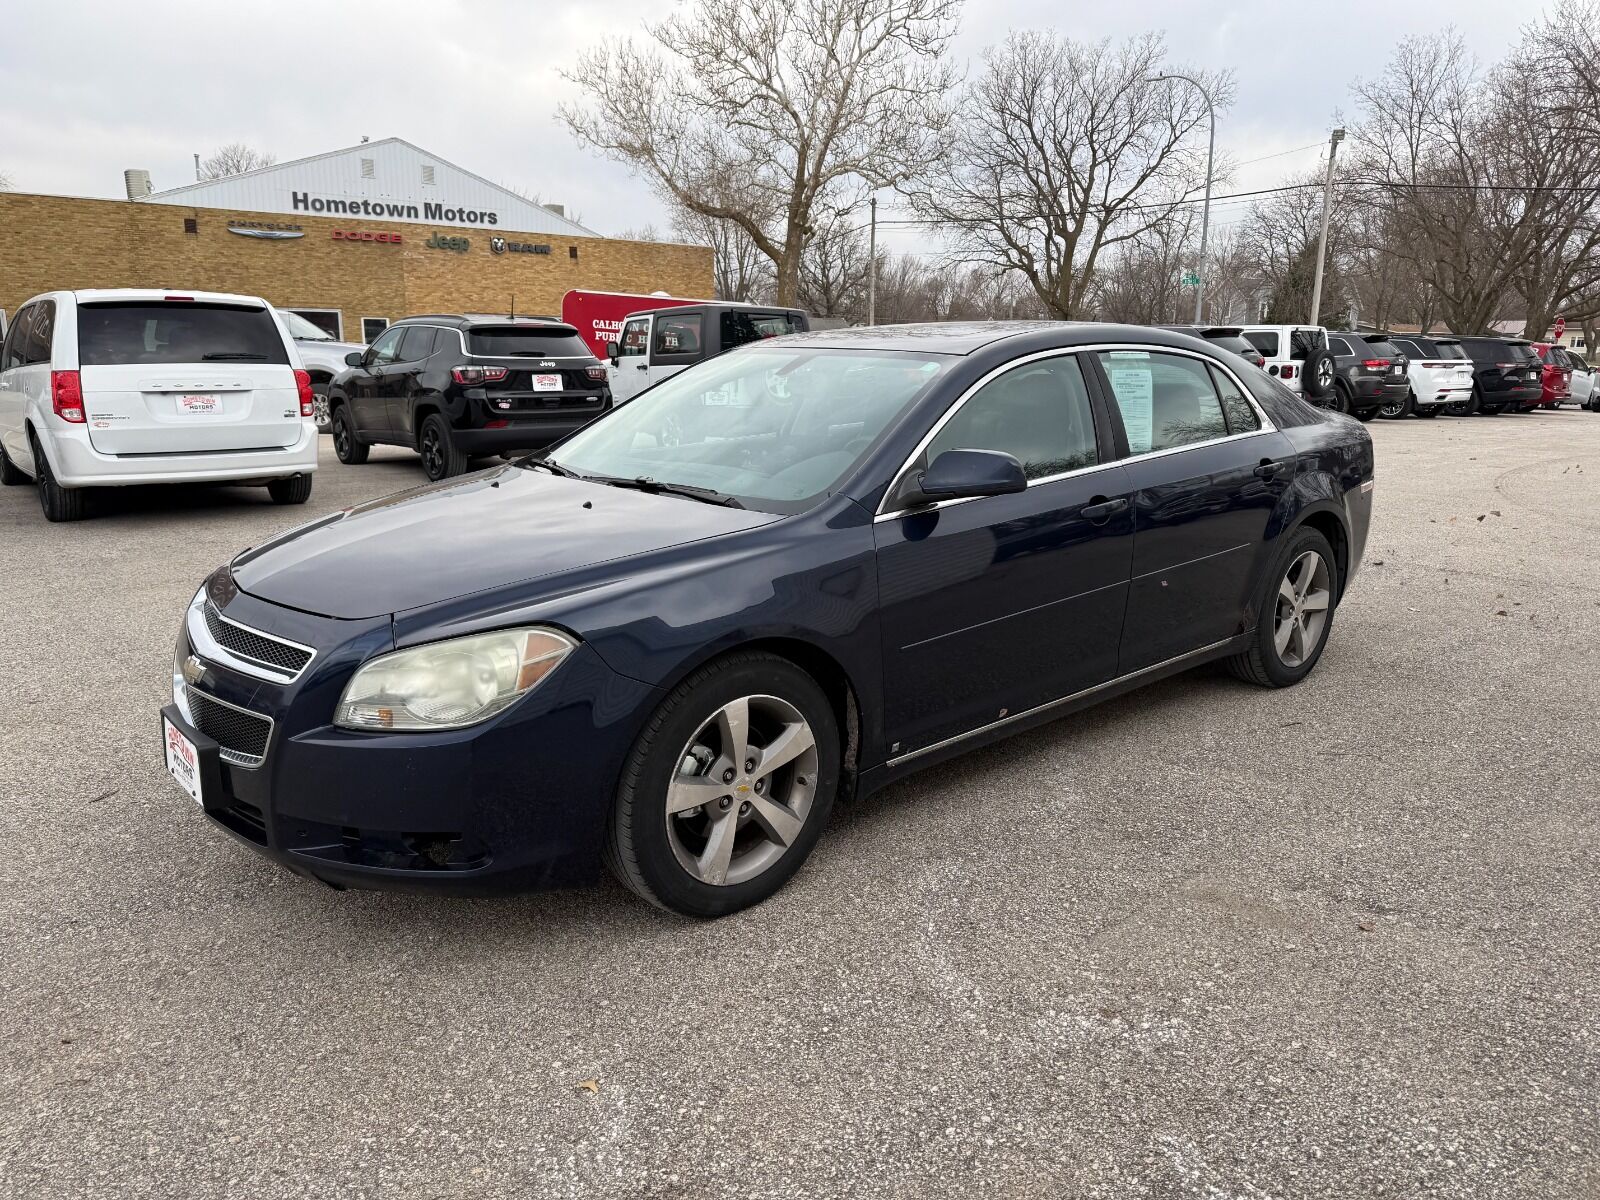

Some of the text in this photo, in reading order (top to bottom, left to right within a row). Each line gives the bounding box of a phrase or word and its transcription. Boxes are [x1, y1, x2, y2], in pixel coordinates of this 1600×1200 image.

[292, 191, 498, 225] Hometown Motors
[332, 229, 402, 244] DODGE
[426, 231, 470, 252] Jeep
[508, 242, 551, 254] RAM
[173, 753, 194, 780] MOTORS
